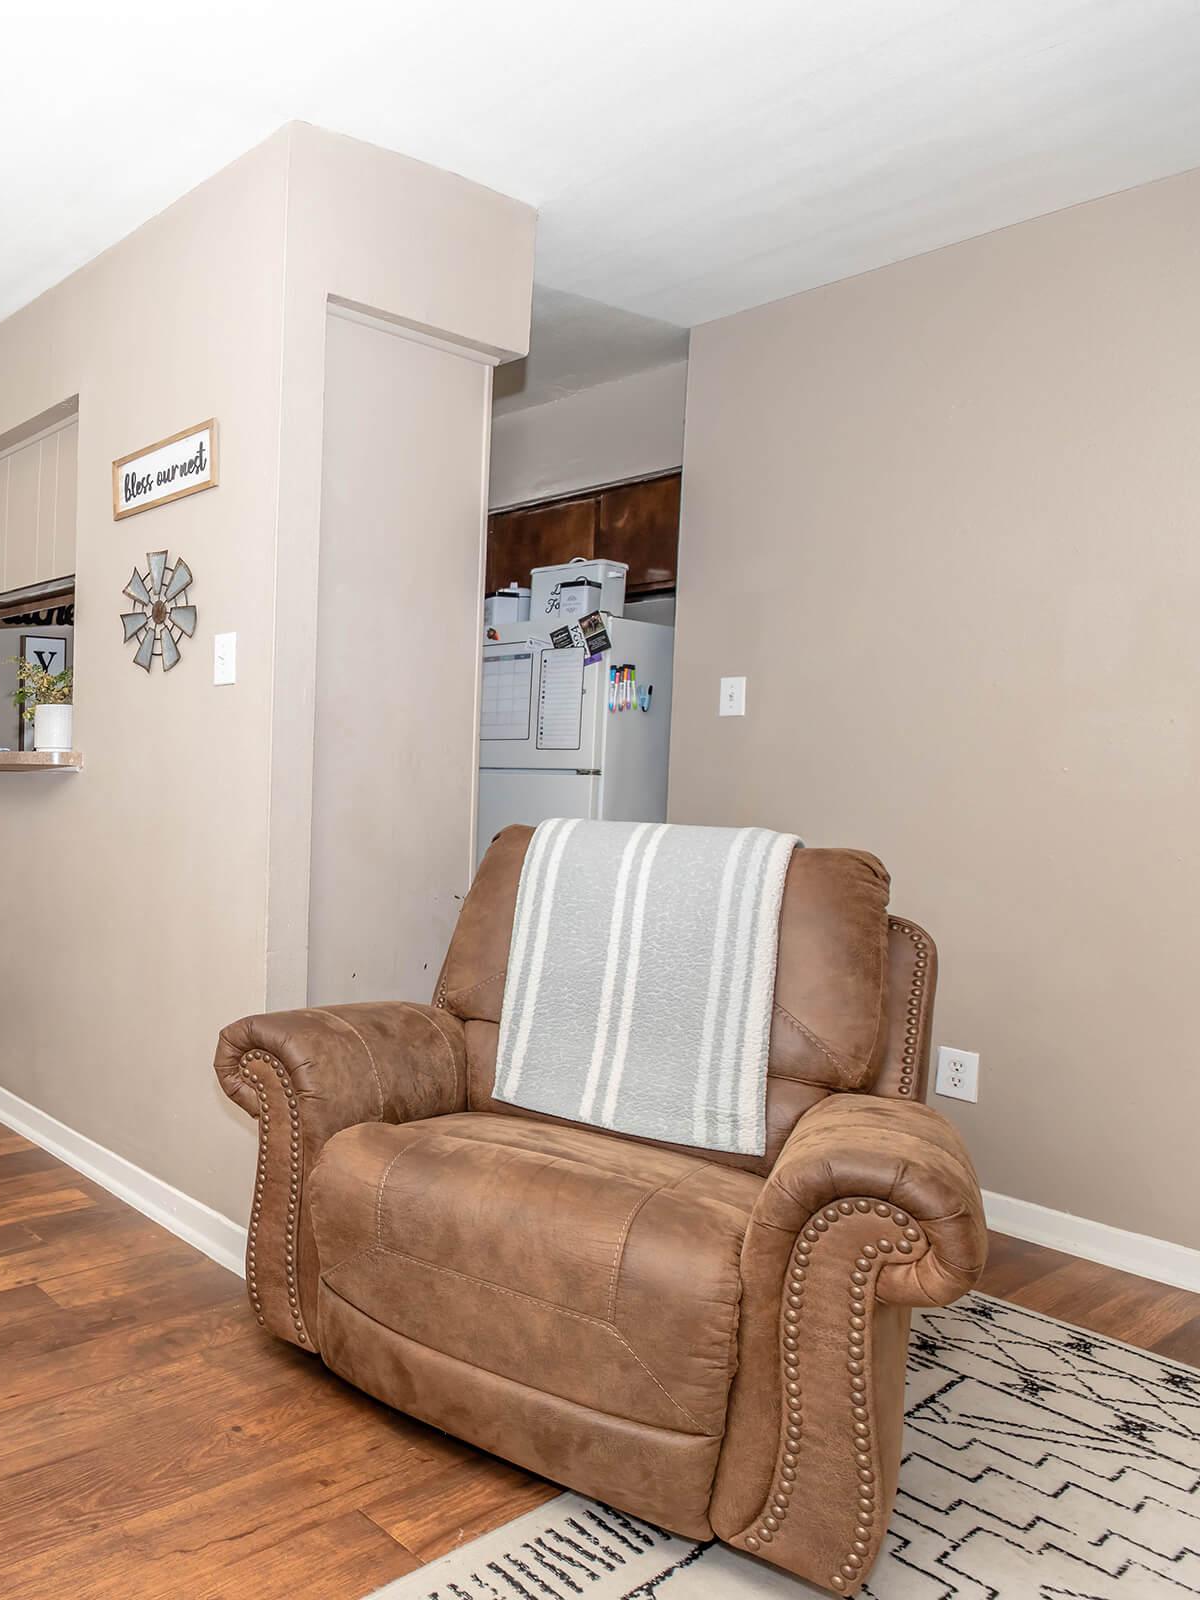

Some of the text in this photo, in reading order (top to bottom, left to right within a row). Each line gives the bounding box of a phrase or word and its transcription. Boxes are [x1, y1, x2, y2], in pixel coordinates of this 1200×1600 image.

[124, 441, 207, 502] bless our nest
